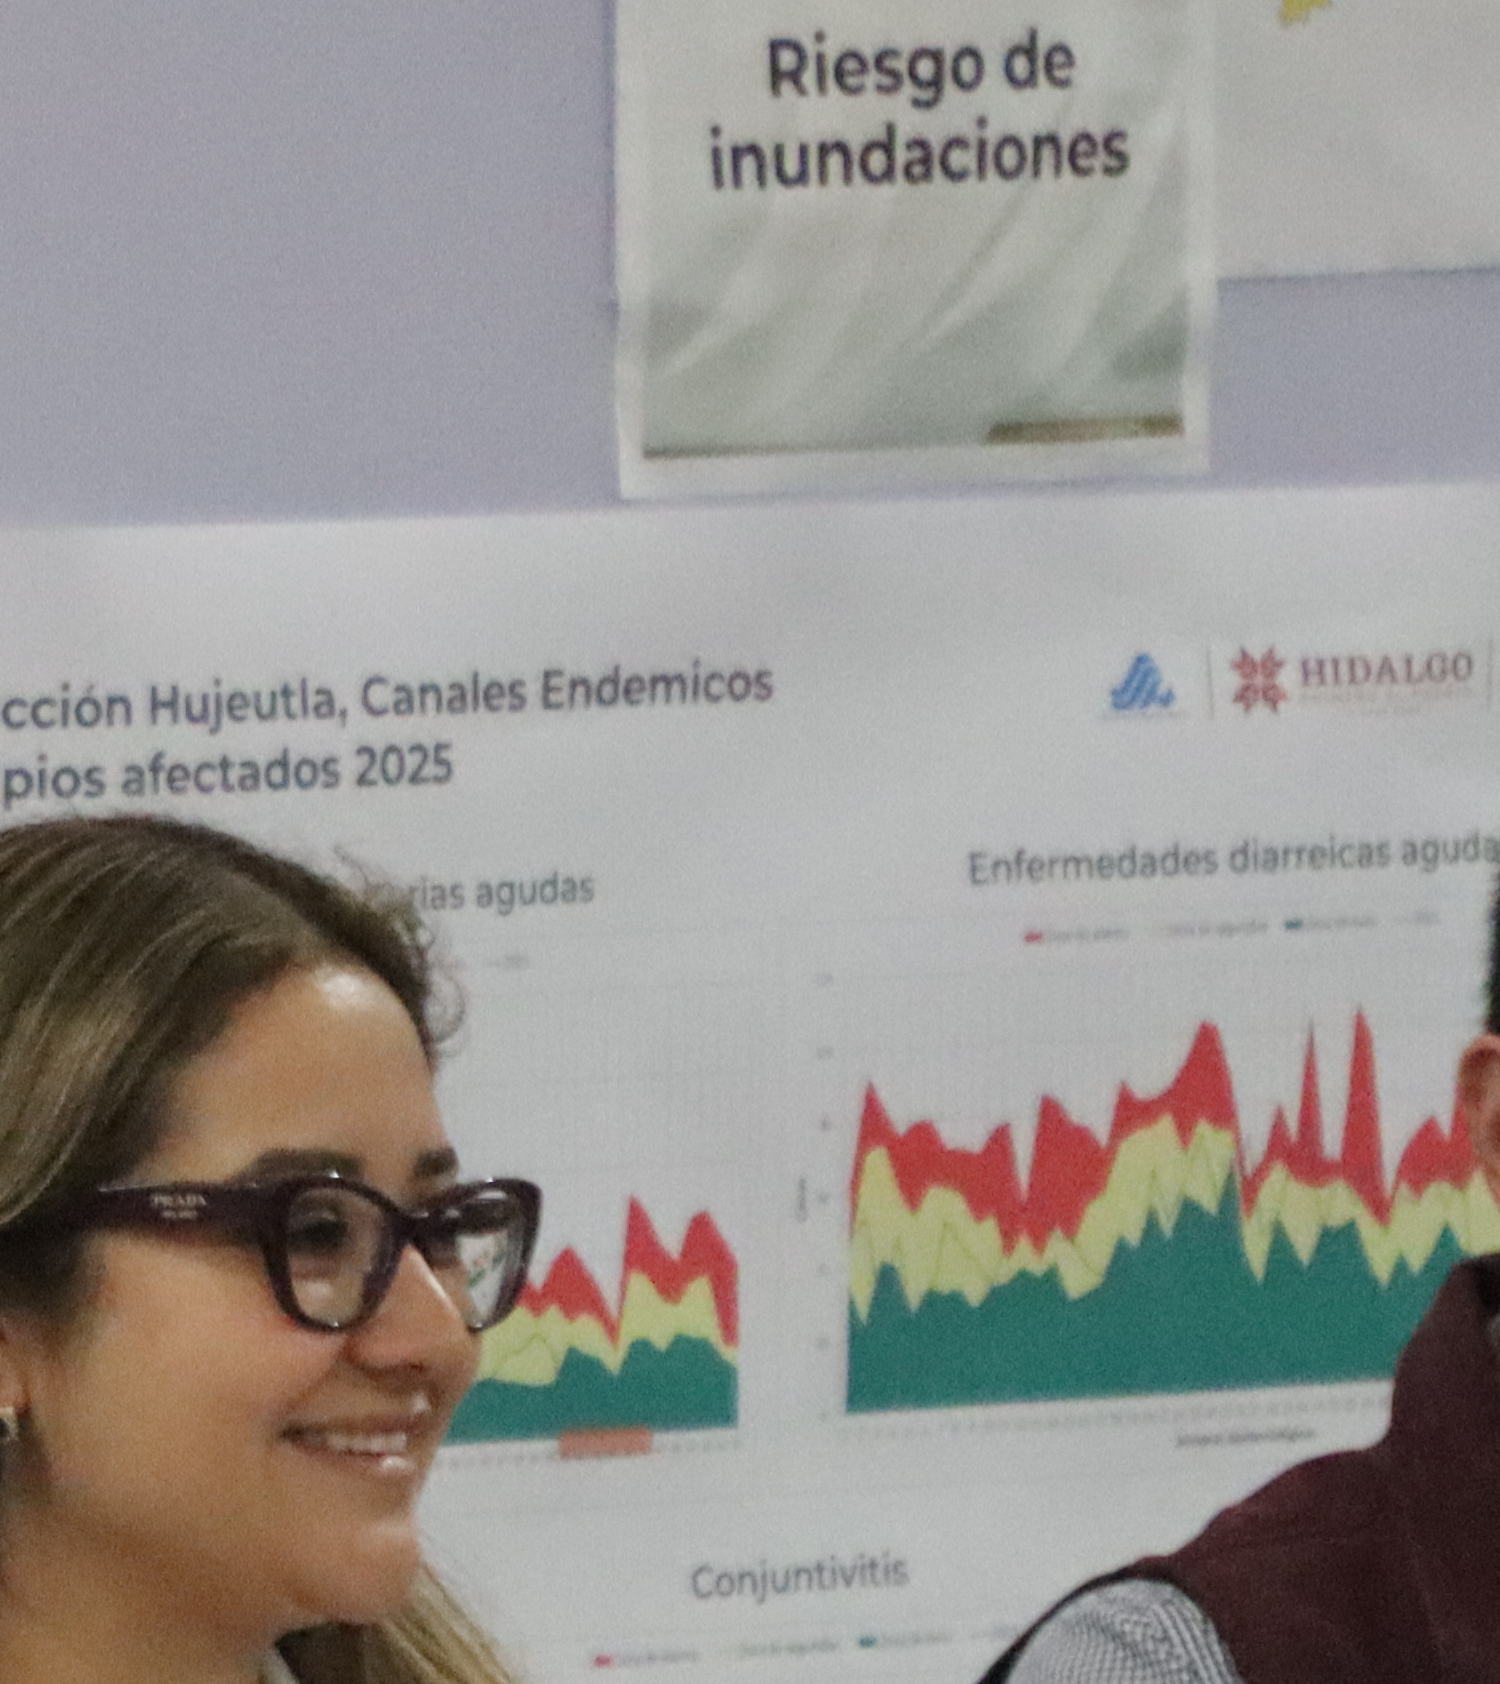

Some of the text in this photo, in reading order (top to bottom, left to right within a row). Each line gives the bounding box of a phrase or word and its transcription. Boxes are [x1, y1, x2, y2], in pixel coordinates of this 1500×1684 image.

[766, 29, 1077, 108] Riesgo de
[709, 119, 1132, 191] inundaciones
[149, 676, 349, 734] Hujeutla,
[361, 670, 528, 718] Canales
[540, 660, 774, 712] Endemicos
[1300, 650, 1475, 690] HIDALGO
[121, 745, 342, 800] afectados
[354, 742, 454, 790] 2025
[968, 845, 1220, 888] Enfermedades
[1230, 834, 1392, 876] diarreicas
[476, 871, 596, 916] agudas
[691, 1552, 909, 1604] Conjuntivitis
